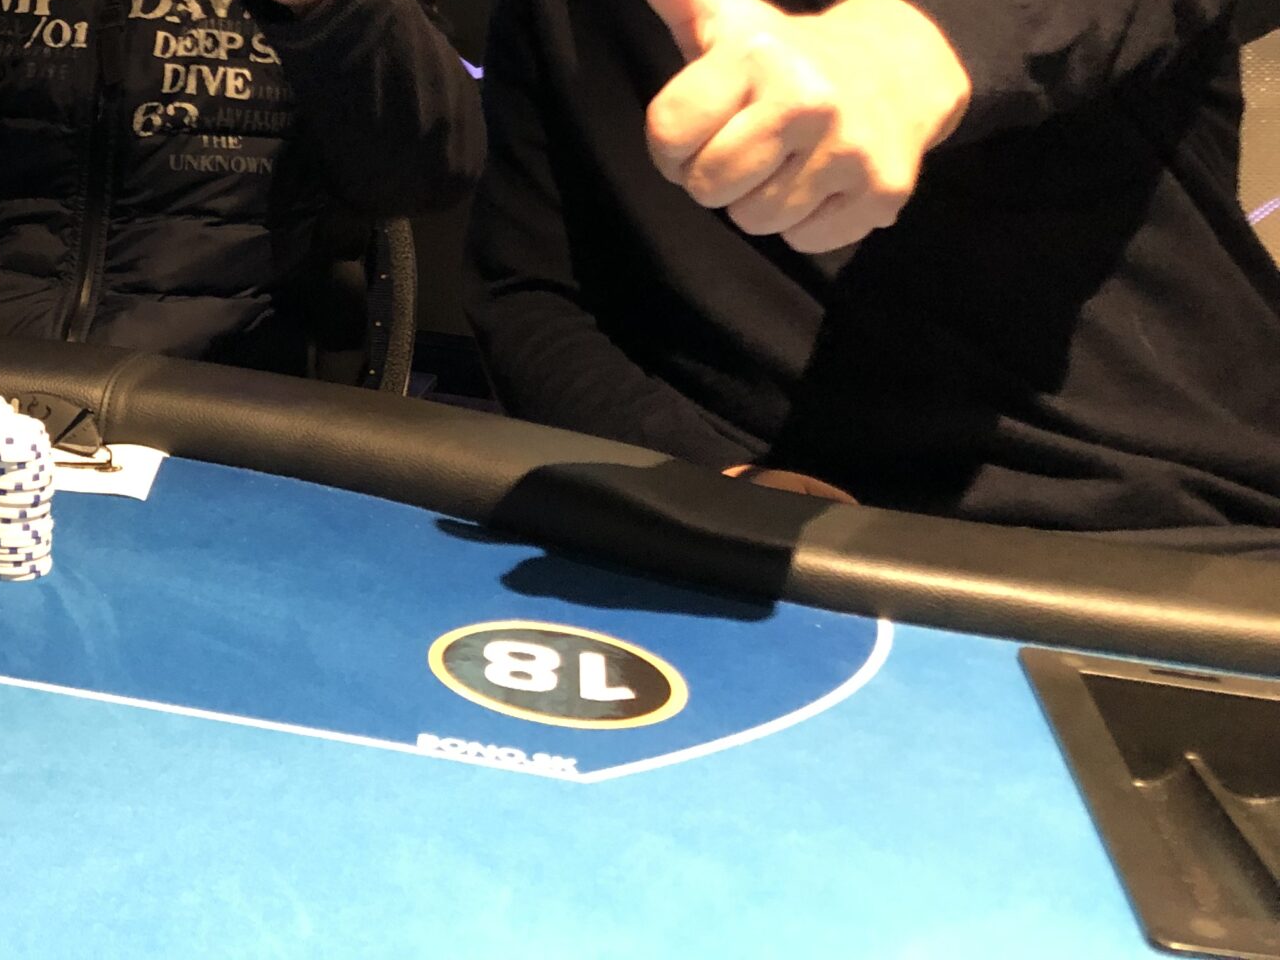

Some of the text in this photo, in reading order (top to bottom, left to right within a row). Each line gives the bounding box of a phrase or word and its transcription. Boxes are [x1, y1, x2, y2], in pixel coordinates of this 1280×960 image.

[152, 28, 245, 61] DEEP
[160, 63, 253, 101] DIVE
[168, 155, 274, 174] UNKNOWN
